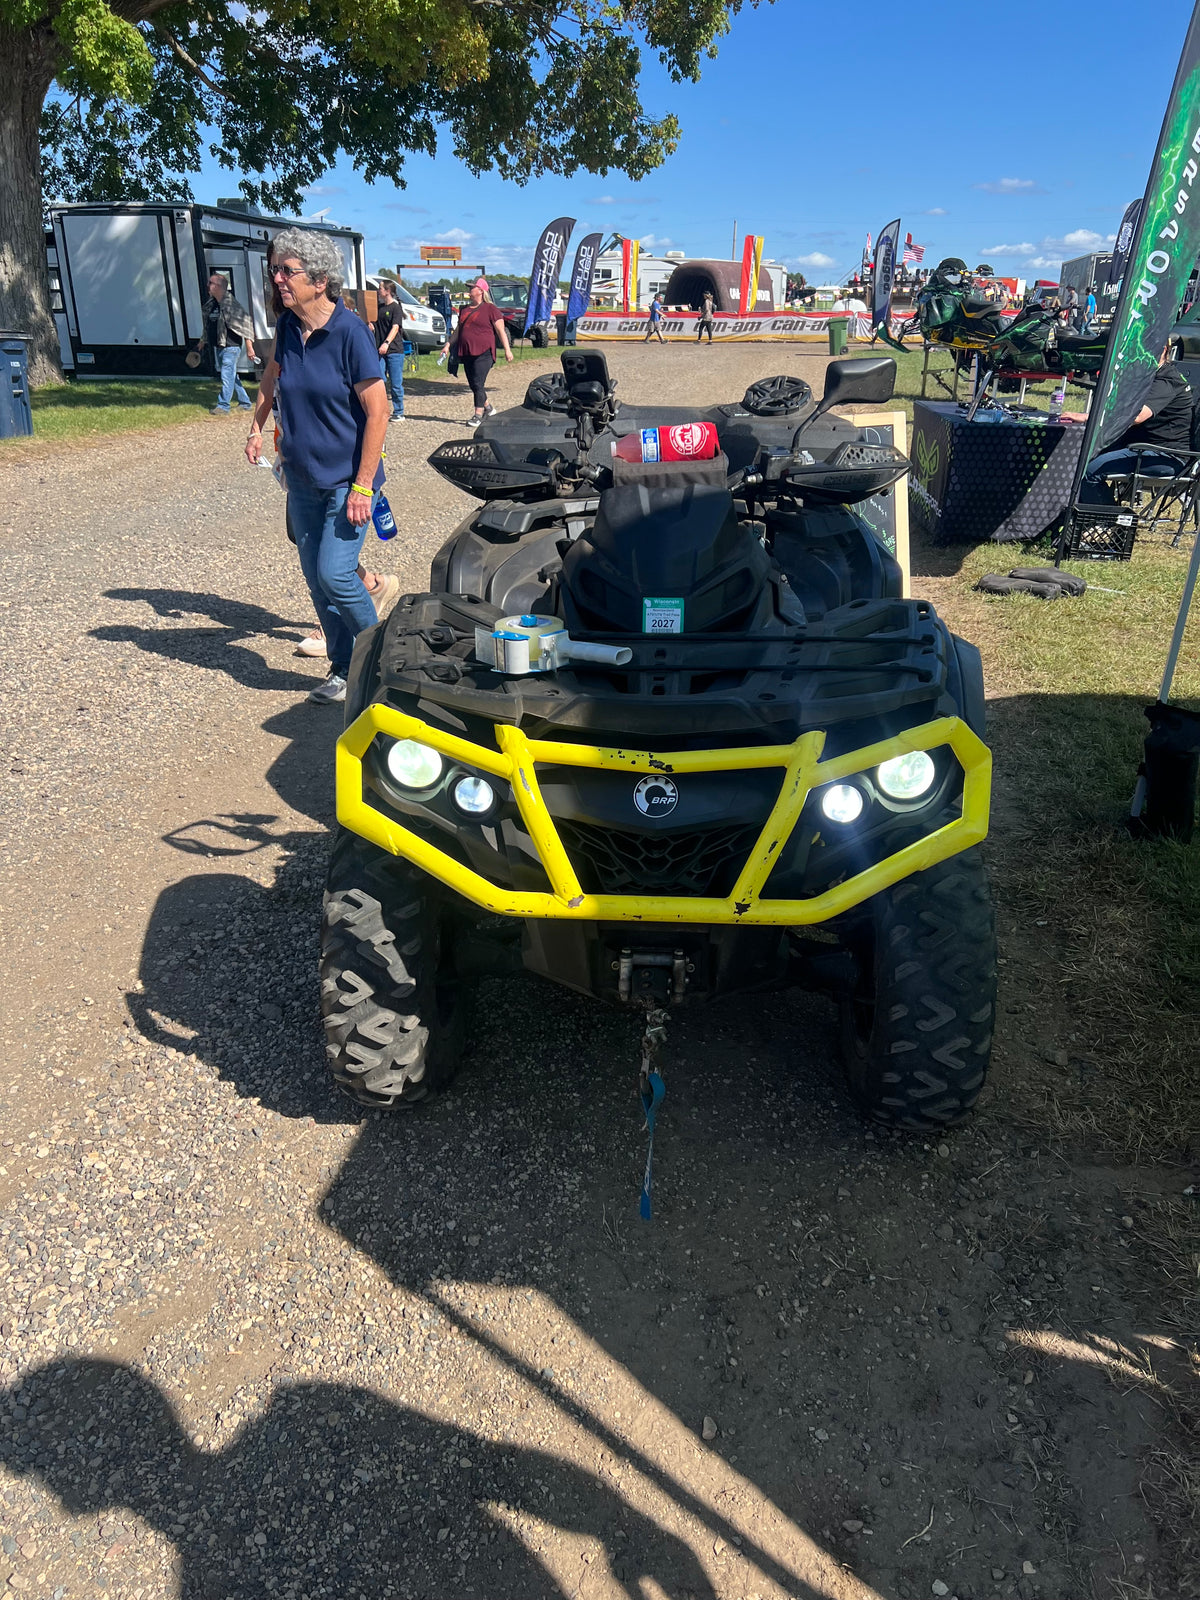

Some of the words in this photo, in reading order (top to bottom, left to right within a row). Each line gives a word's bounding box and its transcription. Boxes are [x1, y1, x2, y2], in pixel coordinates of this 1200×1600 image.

[537, 231, 555, 287] QUAD
[543, 233, 563, 289] LOGIC
[575, 245, 588, 290] QUAD
[580, 246, 594, 291] LOGIC
[617, 320, 685, 332] canam
[684, 430, 693, 455] LOCAL
[652, 619, 675, 628] 2027
[651, 796, 676, 805] BRP
